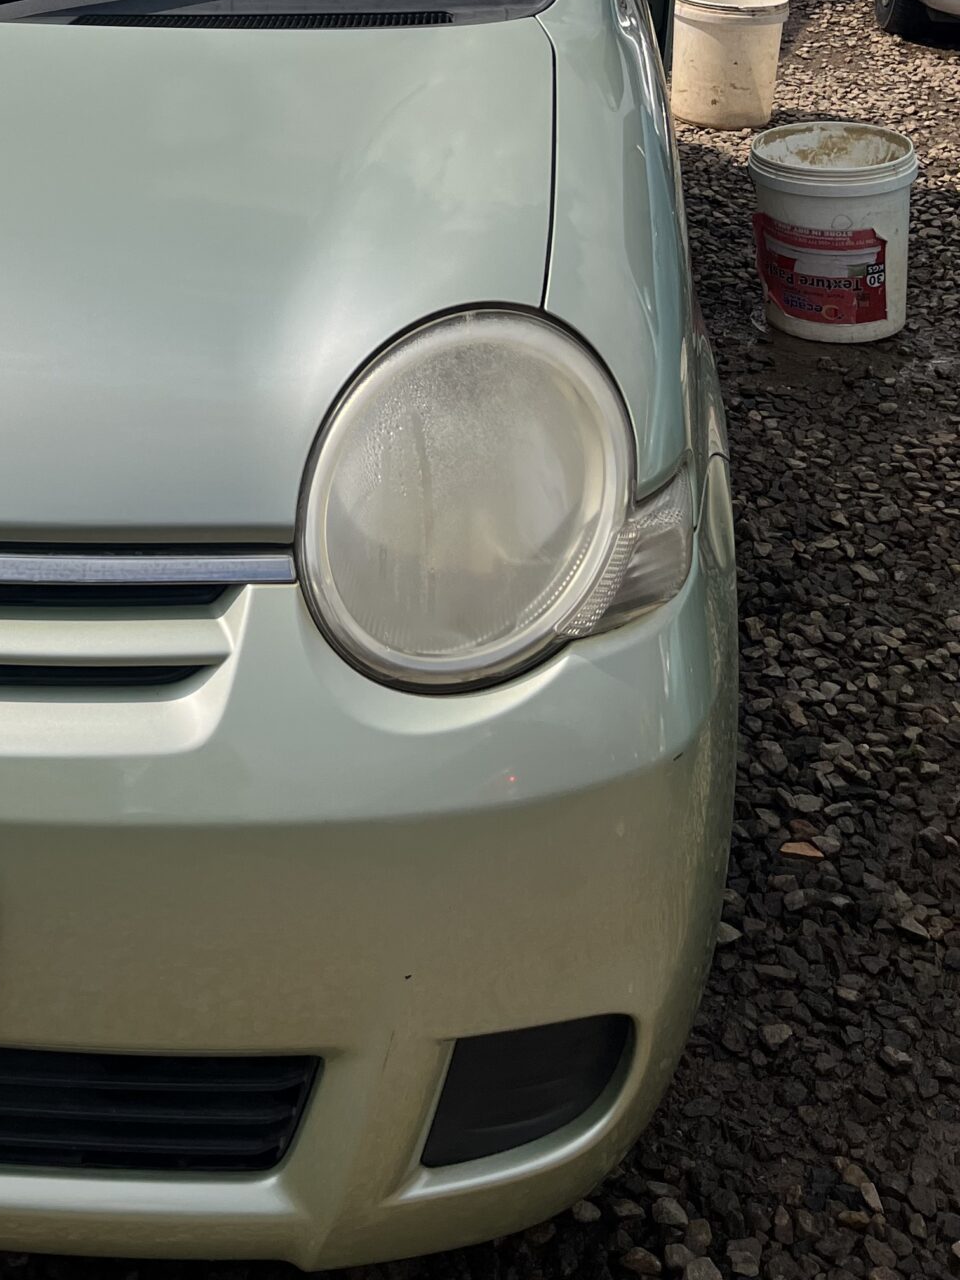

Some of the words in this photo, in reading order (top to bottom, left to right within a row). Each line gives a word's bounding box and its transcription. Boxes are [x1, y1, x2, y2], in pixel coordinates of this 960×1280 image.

[867, 264, 884, 273] KGS
[800, 275, 862, 291] Texture
[869, 274, 883, 286] 30
